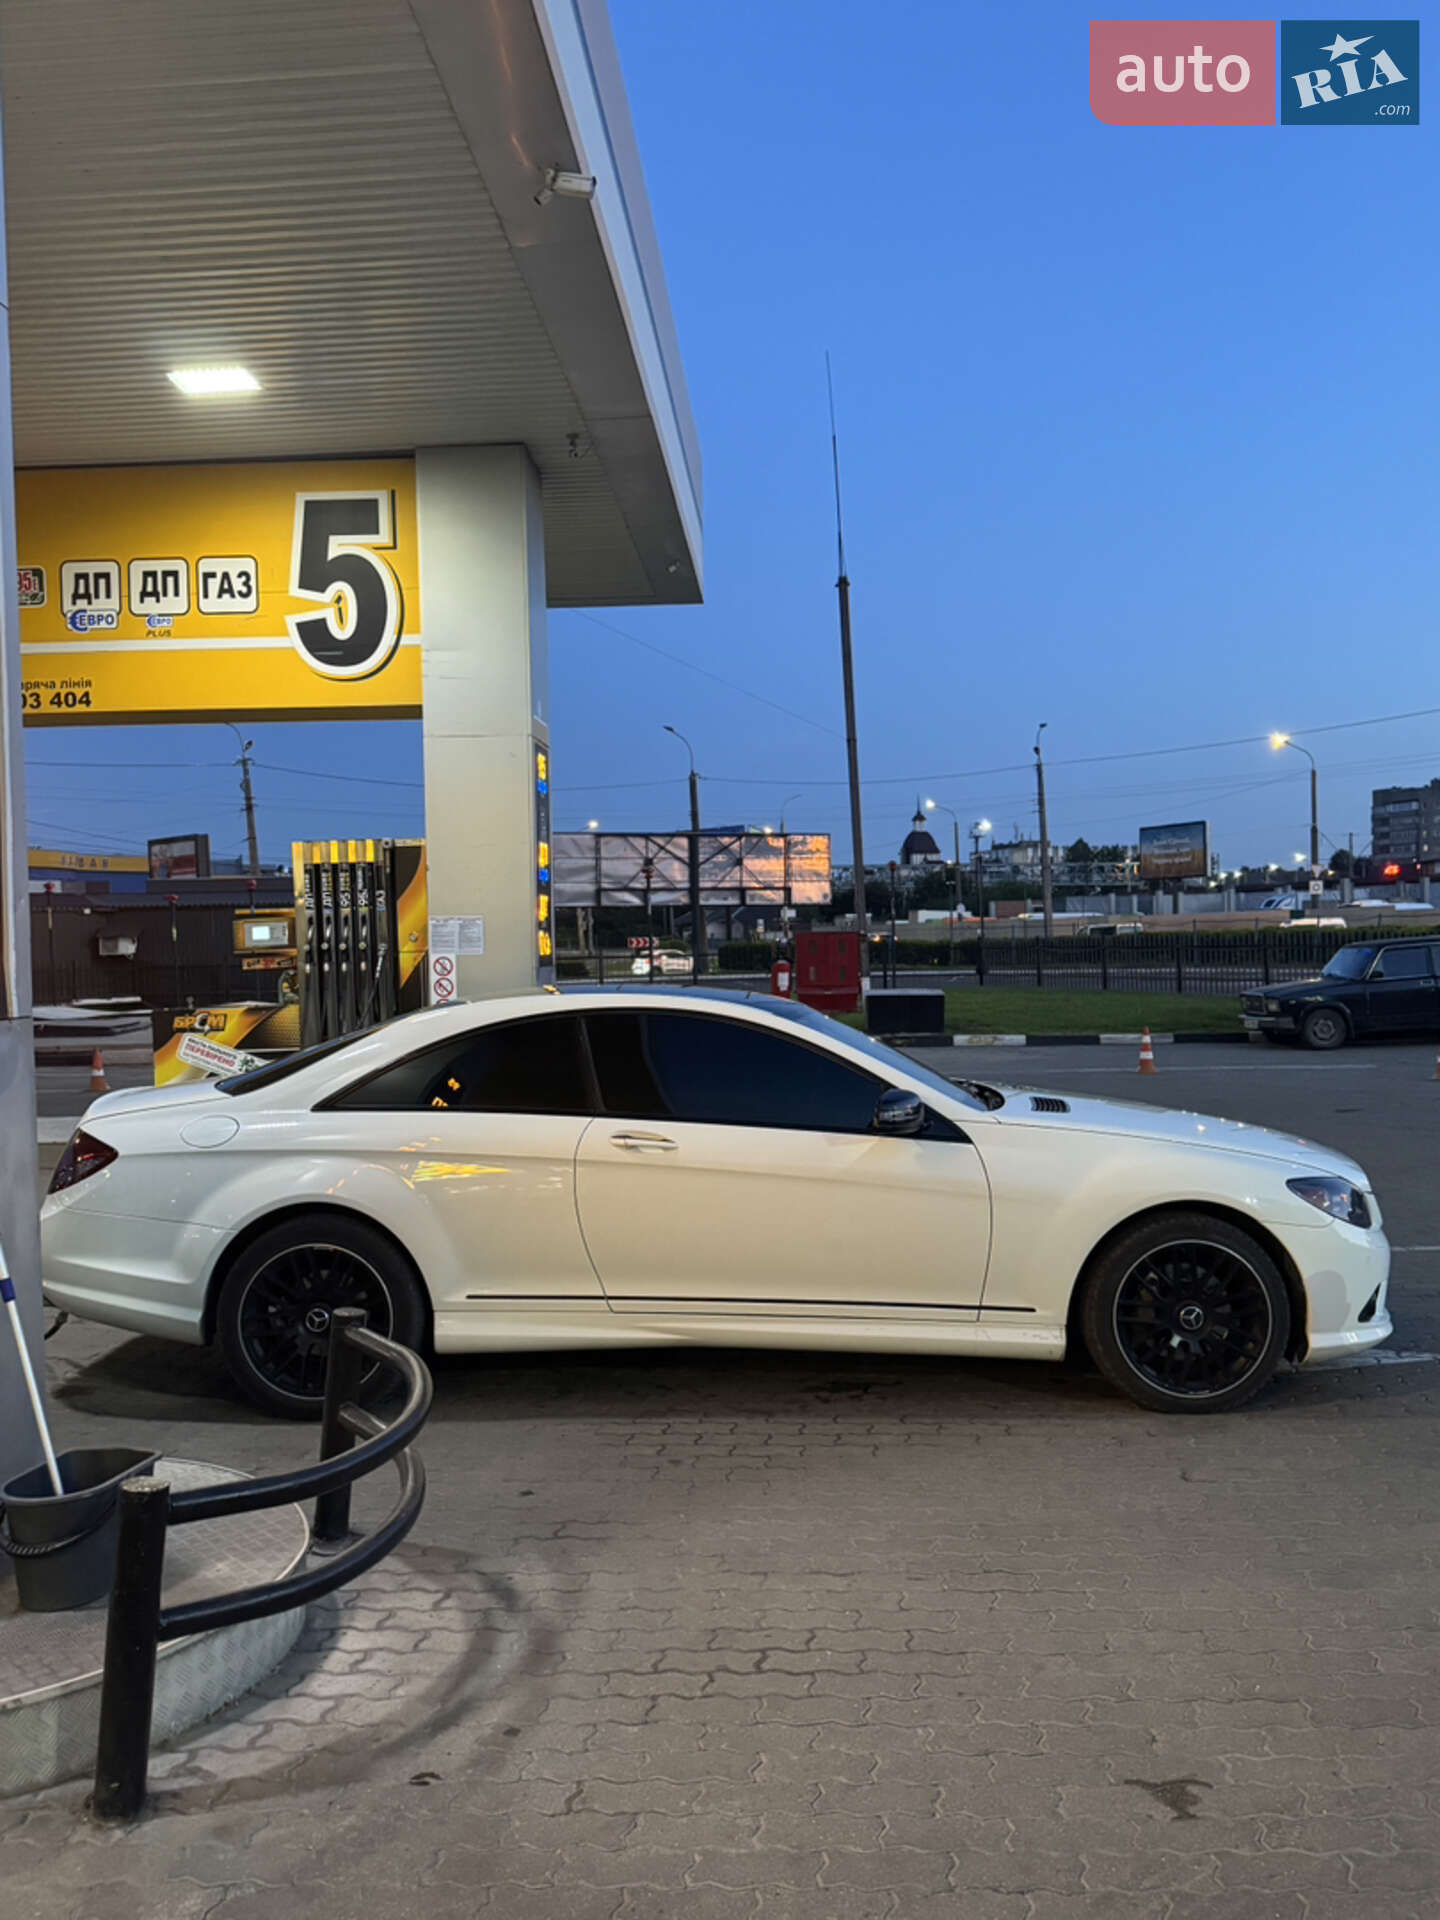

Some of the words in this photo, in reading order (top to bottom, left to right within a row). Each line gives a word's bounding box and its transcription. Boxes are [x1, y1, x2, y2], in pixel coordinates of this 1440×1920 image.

[71, 571, 112, 606] ДП
[139, 570, 180, 604] ДП
[202, 570, 253, 599] ГАЗ
[288, 491, 398, 676] 5
[49, 691, 92, 708] 404
